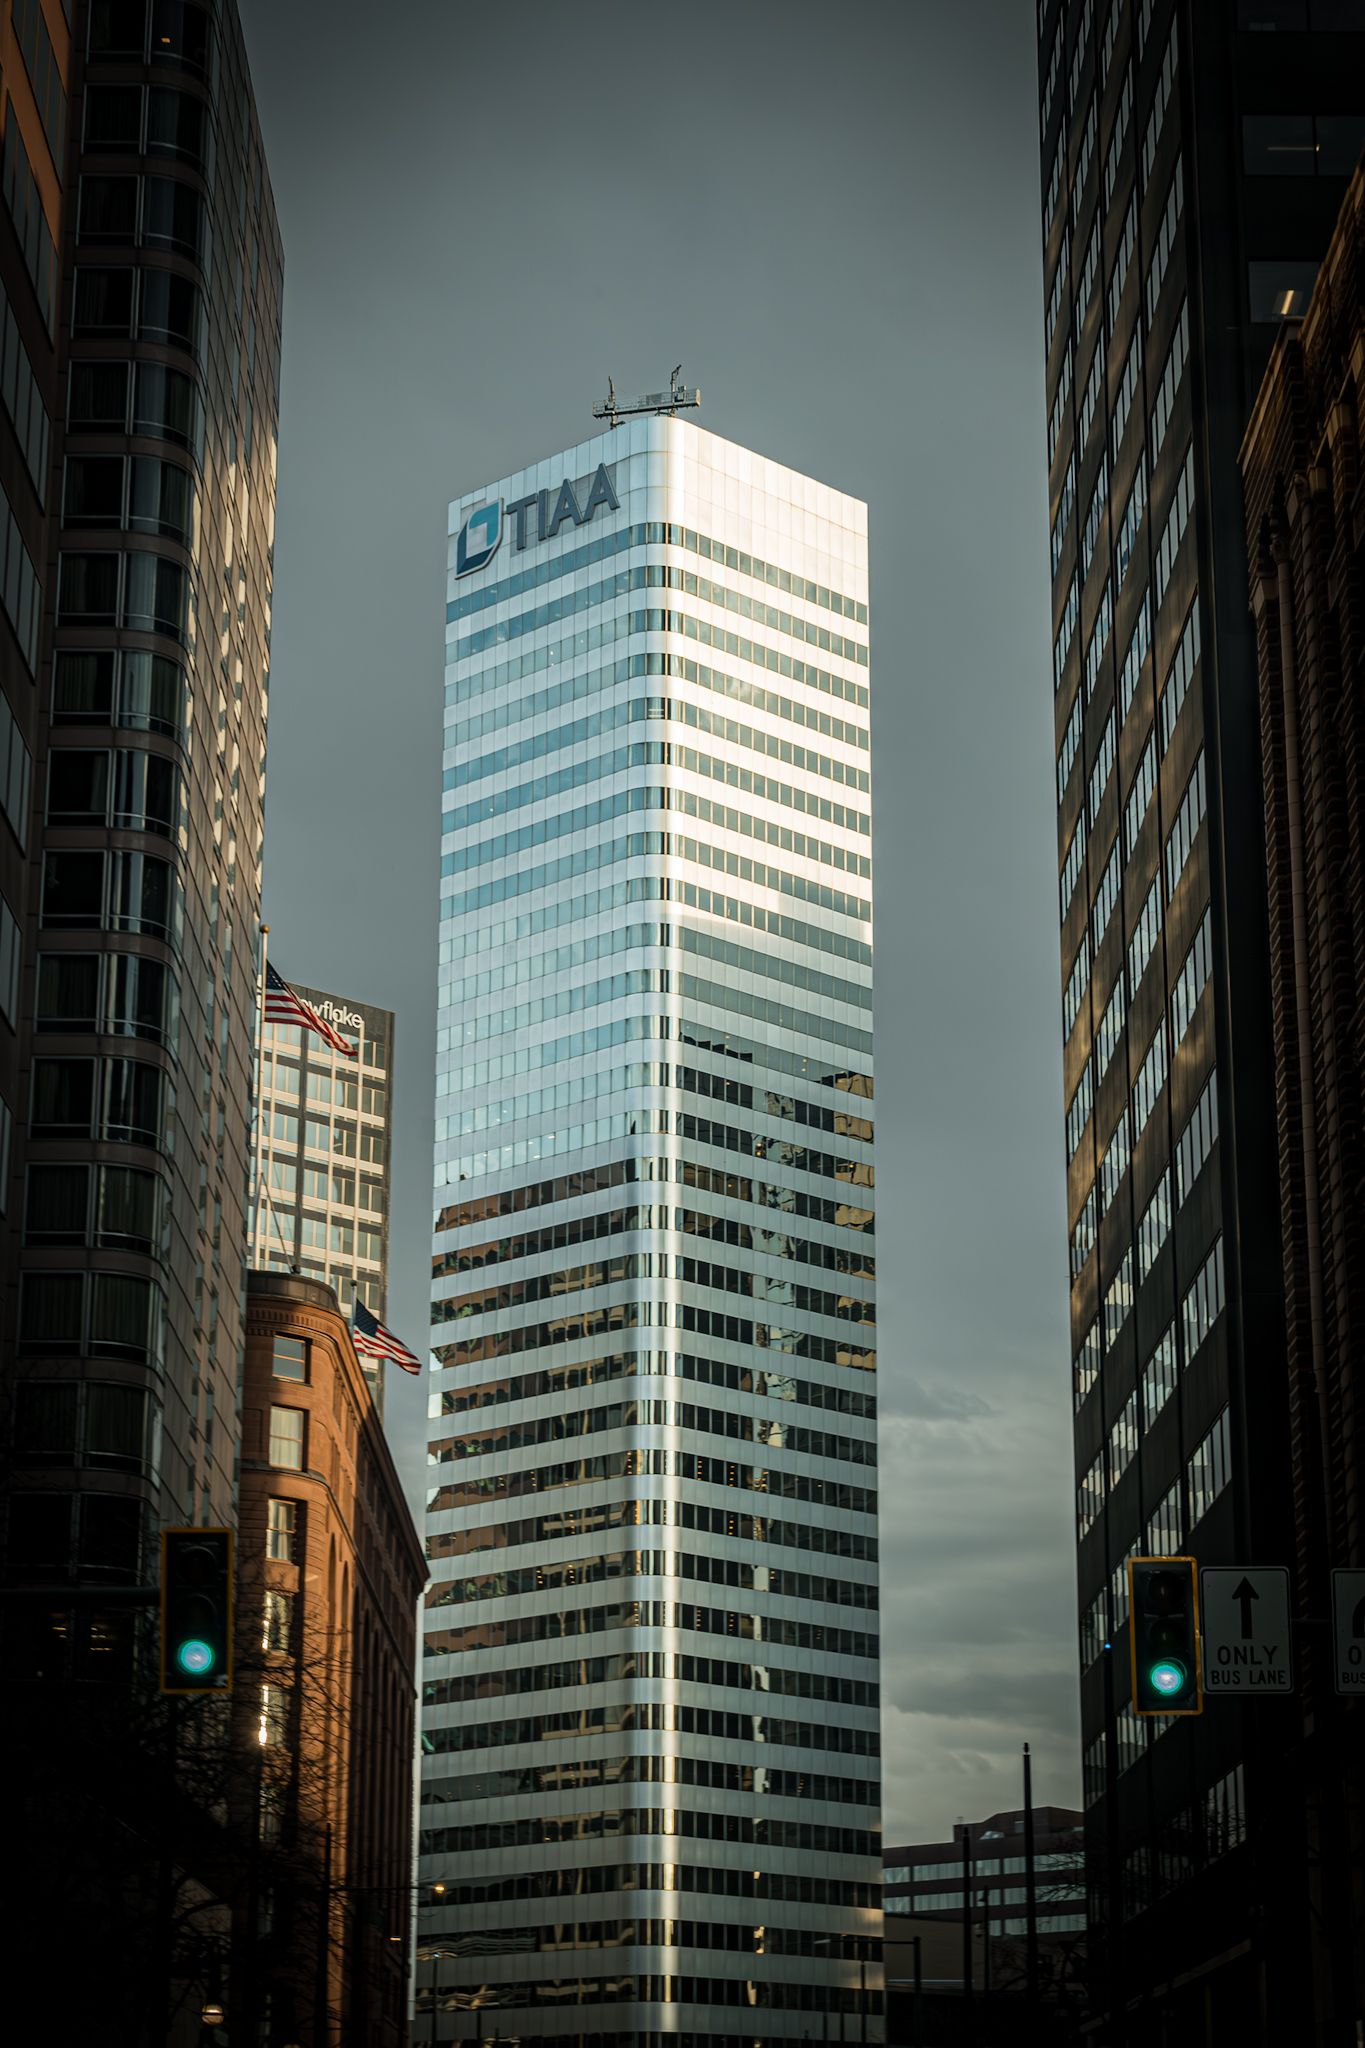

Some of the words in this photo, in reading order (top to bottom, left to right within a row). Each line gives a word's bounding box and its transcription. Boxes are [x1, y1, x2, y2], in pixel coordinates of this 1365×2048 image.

[506, 463, 620, 551] TIAA
[1217, 1645, 1278, 1665] ONLY
[1211, 1670, 1240, 1685] BUS
[1249, 1670, 1286, 1685] LANE
[1342, 1671, 1365, 1684] BUS
